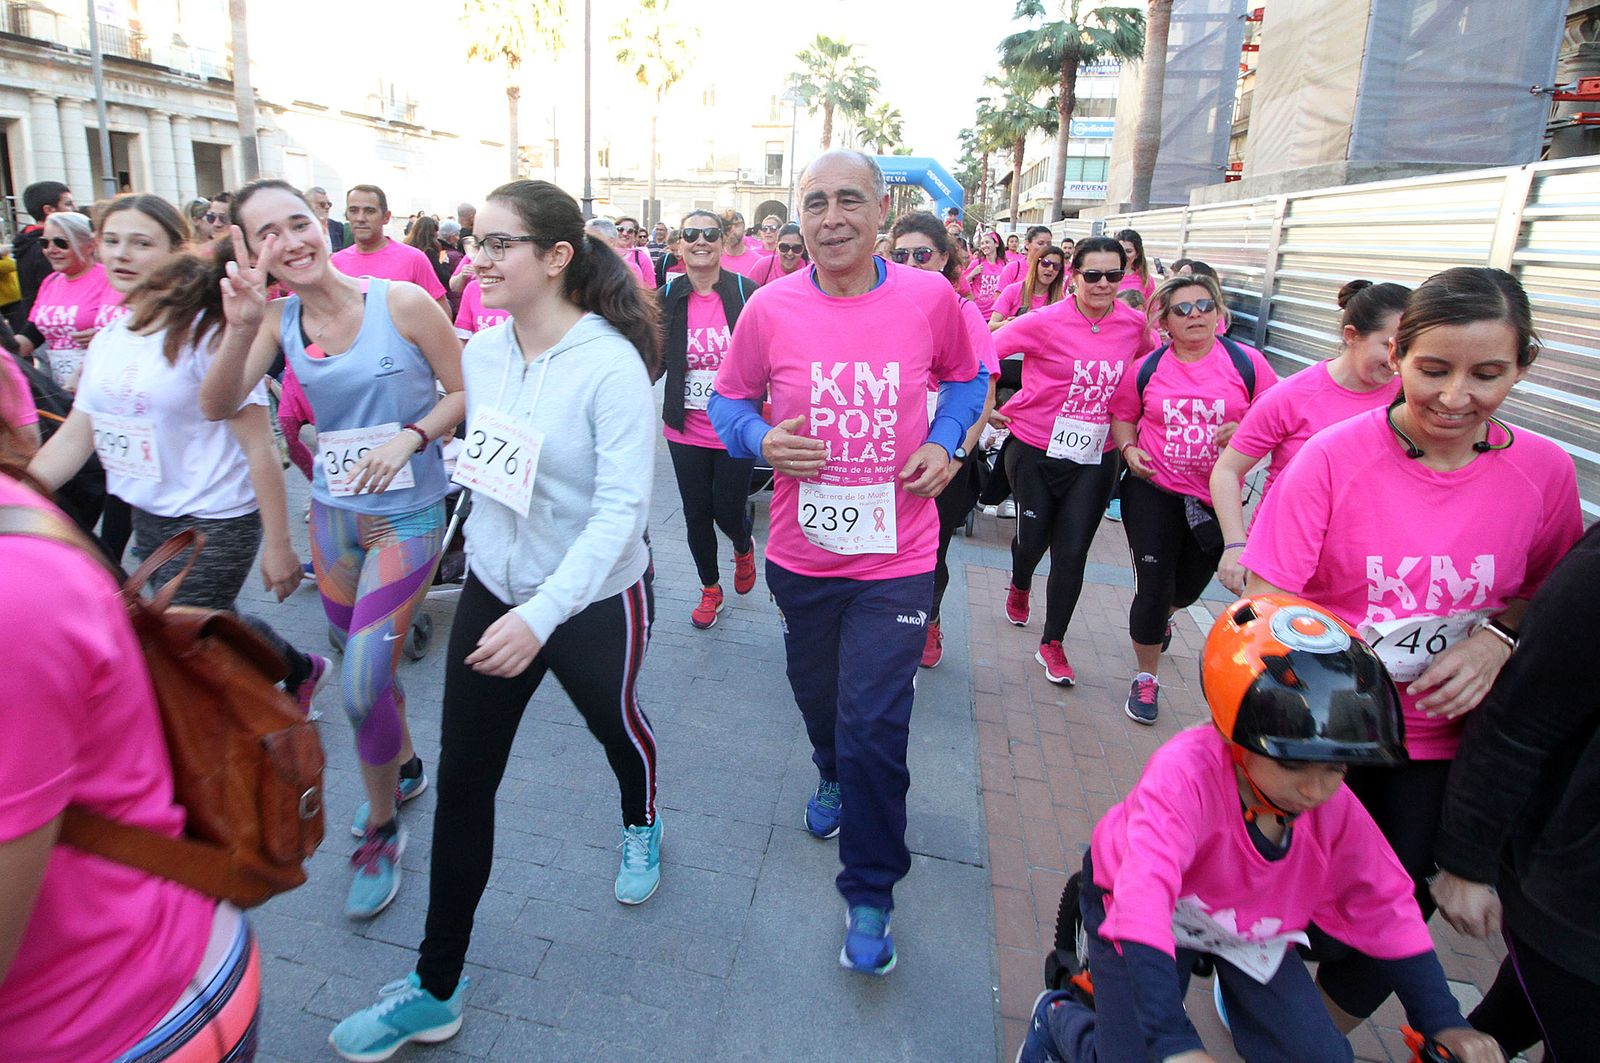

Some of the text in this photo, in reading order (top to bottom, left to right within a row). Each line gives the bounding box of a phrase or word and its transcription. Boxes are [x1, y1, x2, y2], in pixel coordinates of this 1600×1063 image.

[72, 72, 168, 97] AYUTAMIENTO
[36, 304, 79, 325] KM
[810, 362, 900, 406] KM
[1073, 360, 1123, 385] KM
[1067, 384, 1115, 402] POR
[810, 407, 898, 439] POR
[1163, 399, 1225, 424] KM
[467, 430, 520, 475] 376
[826, 440, 896, 463] LLAS
[1054, 430, 1091, 450] 409
[820, 465, 847, 473] arrera
[875, 465, 896, 474] Mujer
[814, 491, 841, 500] Carrera
[803, 503, 859, 533] 239
[1366, 554, 1495, 611] KM
[896, 614, 921, 625] JAKO
